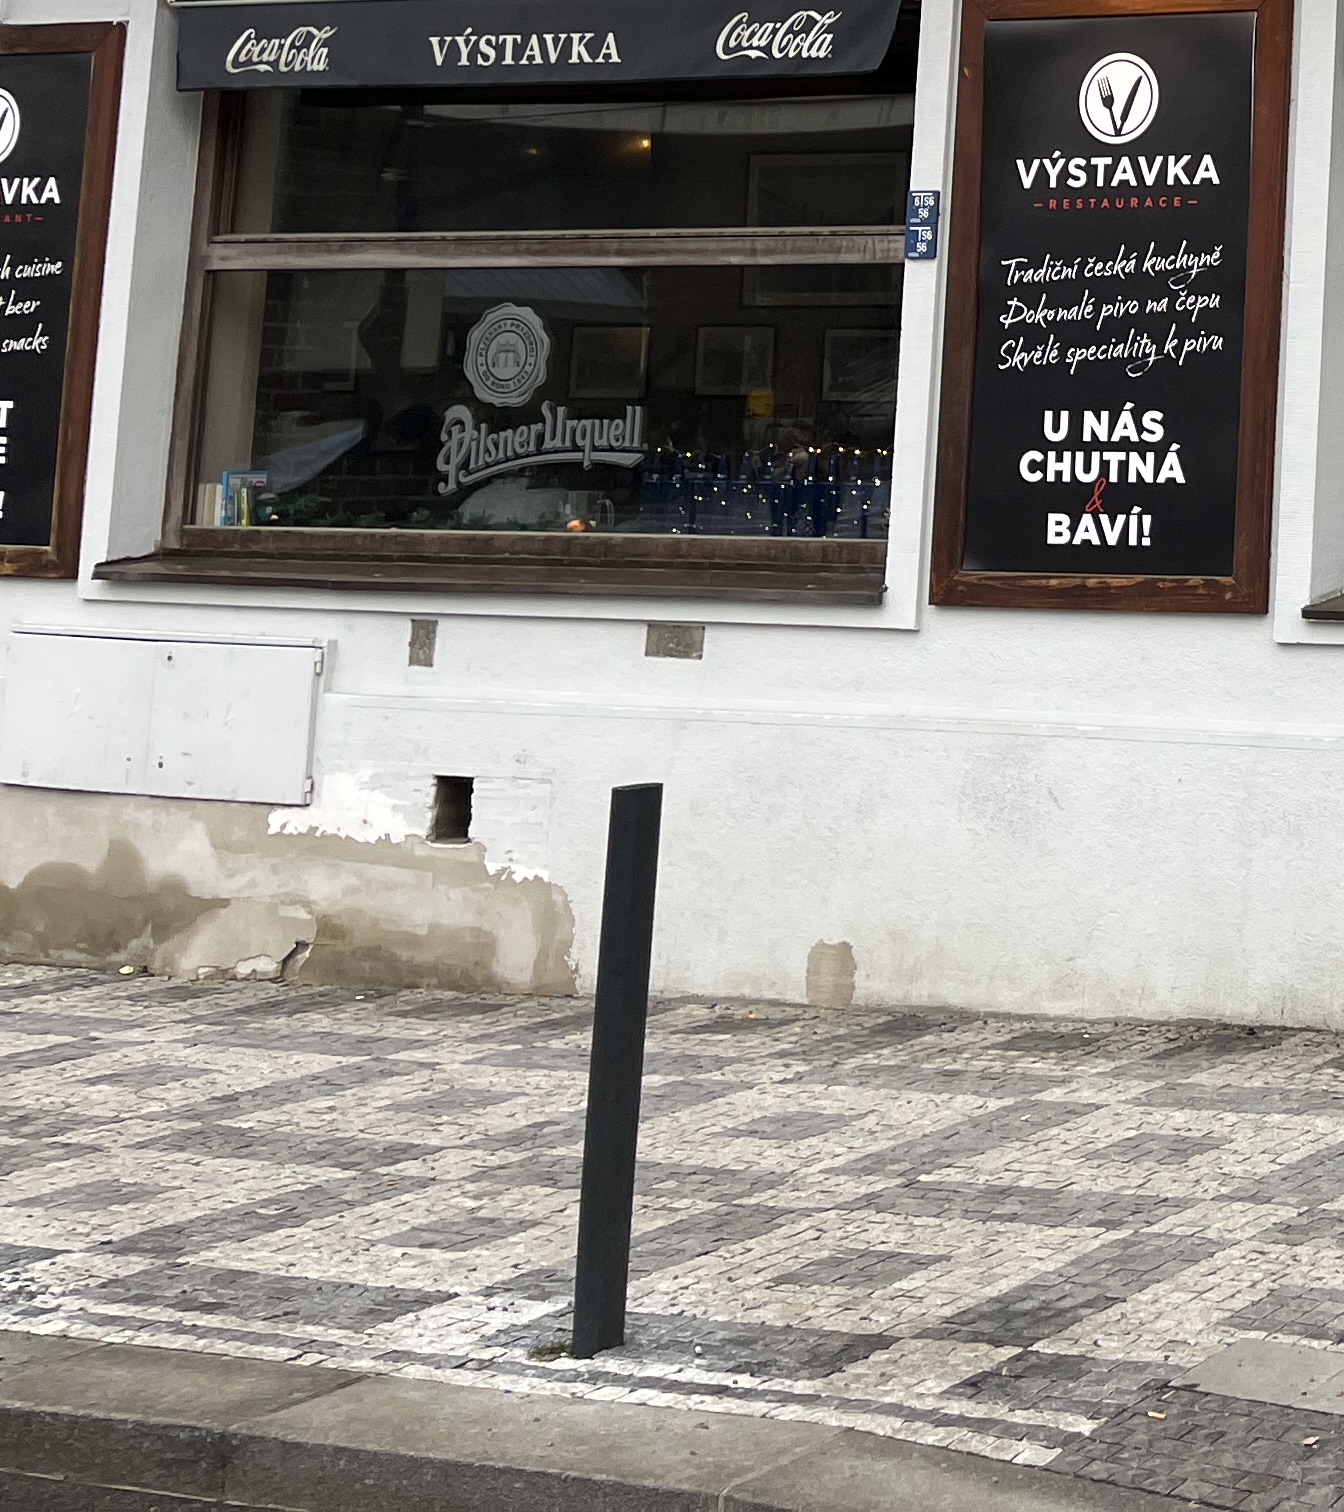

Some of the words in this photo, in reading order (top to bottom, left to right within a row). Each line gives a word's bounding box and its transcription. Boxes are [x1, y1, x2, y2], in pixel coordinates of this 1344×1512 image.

[225, 26, 338, 73] Coca-Cola
[429, 27, 621, 66] VÝSTAVKA
[716, 10, 842, 60] Coca-Cola
[1016, 150, 1220, 189] VÝSTAVKA
[1049, 196, 1182, 209] RESTAURACE
[15, 257, 62, 278] cuisine
[1001, 254, 1081, 286] Tradiční
[1084, 244, 1138, 279] česká
[1142, 240, 1223, 289] kuchyně
[5, 289, 40, 316] beer
[1000, 289, 1095, 329] Dokonalé
[1097, 295, 1138, 331] pivo
[1146, 297, 1167, 314] na
[1175, 290, 1220, 322] čepu
[1, 322, 49, 354] snacks
[998, 334, 1060, 371] Skvělé
[1065, 328, 1165, 377] speciality
[1164, 323, 1178, 359] k
[1179, 331, 1223, 365] pivu
[1043, 410, 1070, 442] U
[1082, 401, 1164, 442] NÁS
[437, 404, 544, 496] Pilsner
[541, 400, 642, 471] Urquell
[1019, 442, 1186, 484] CHUTNÁ
[1085, 477, 1107, 512] &
[1046, 505, 1151, 546] BAVÍ!
